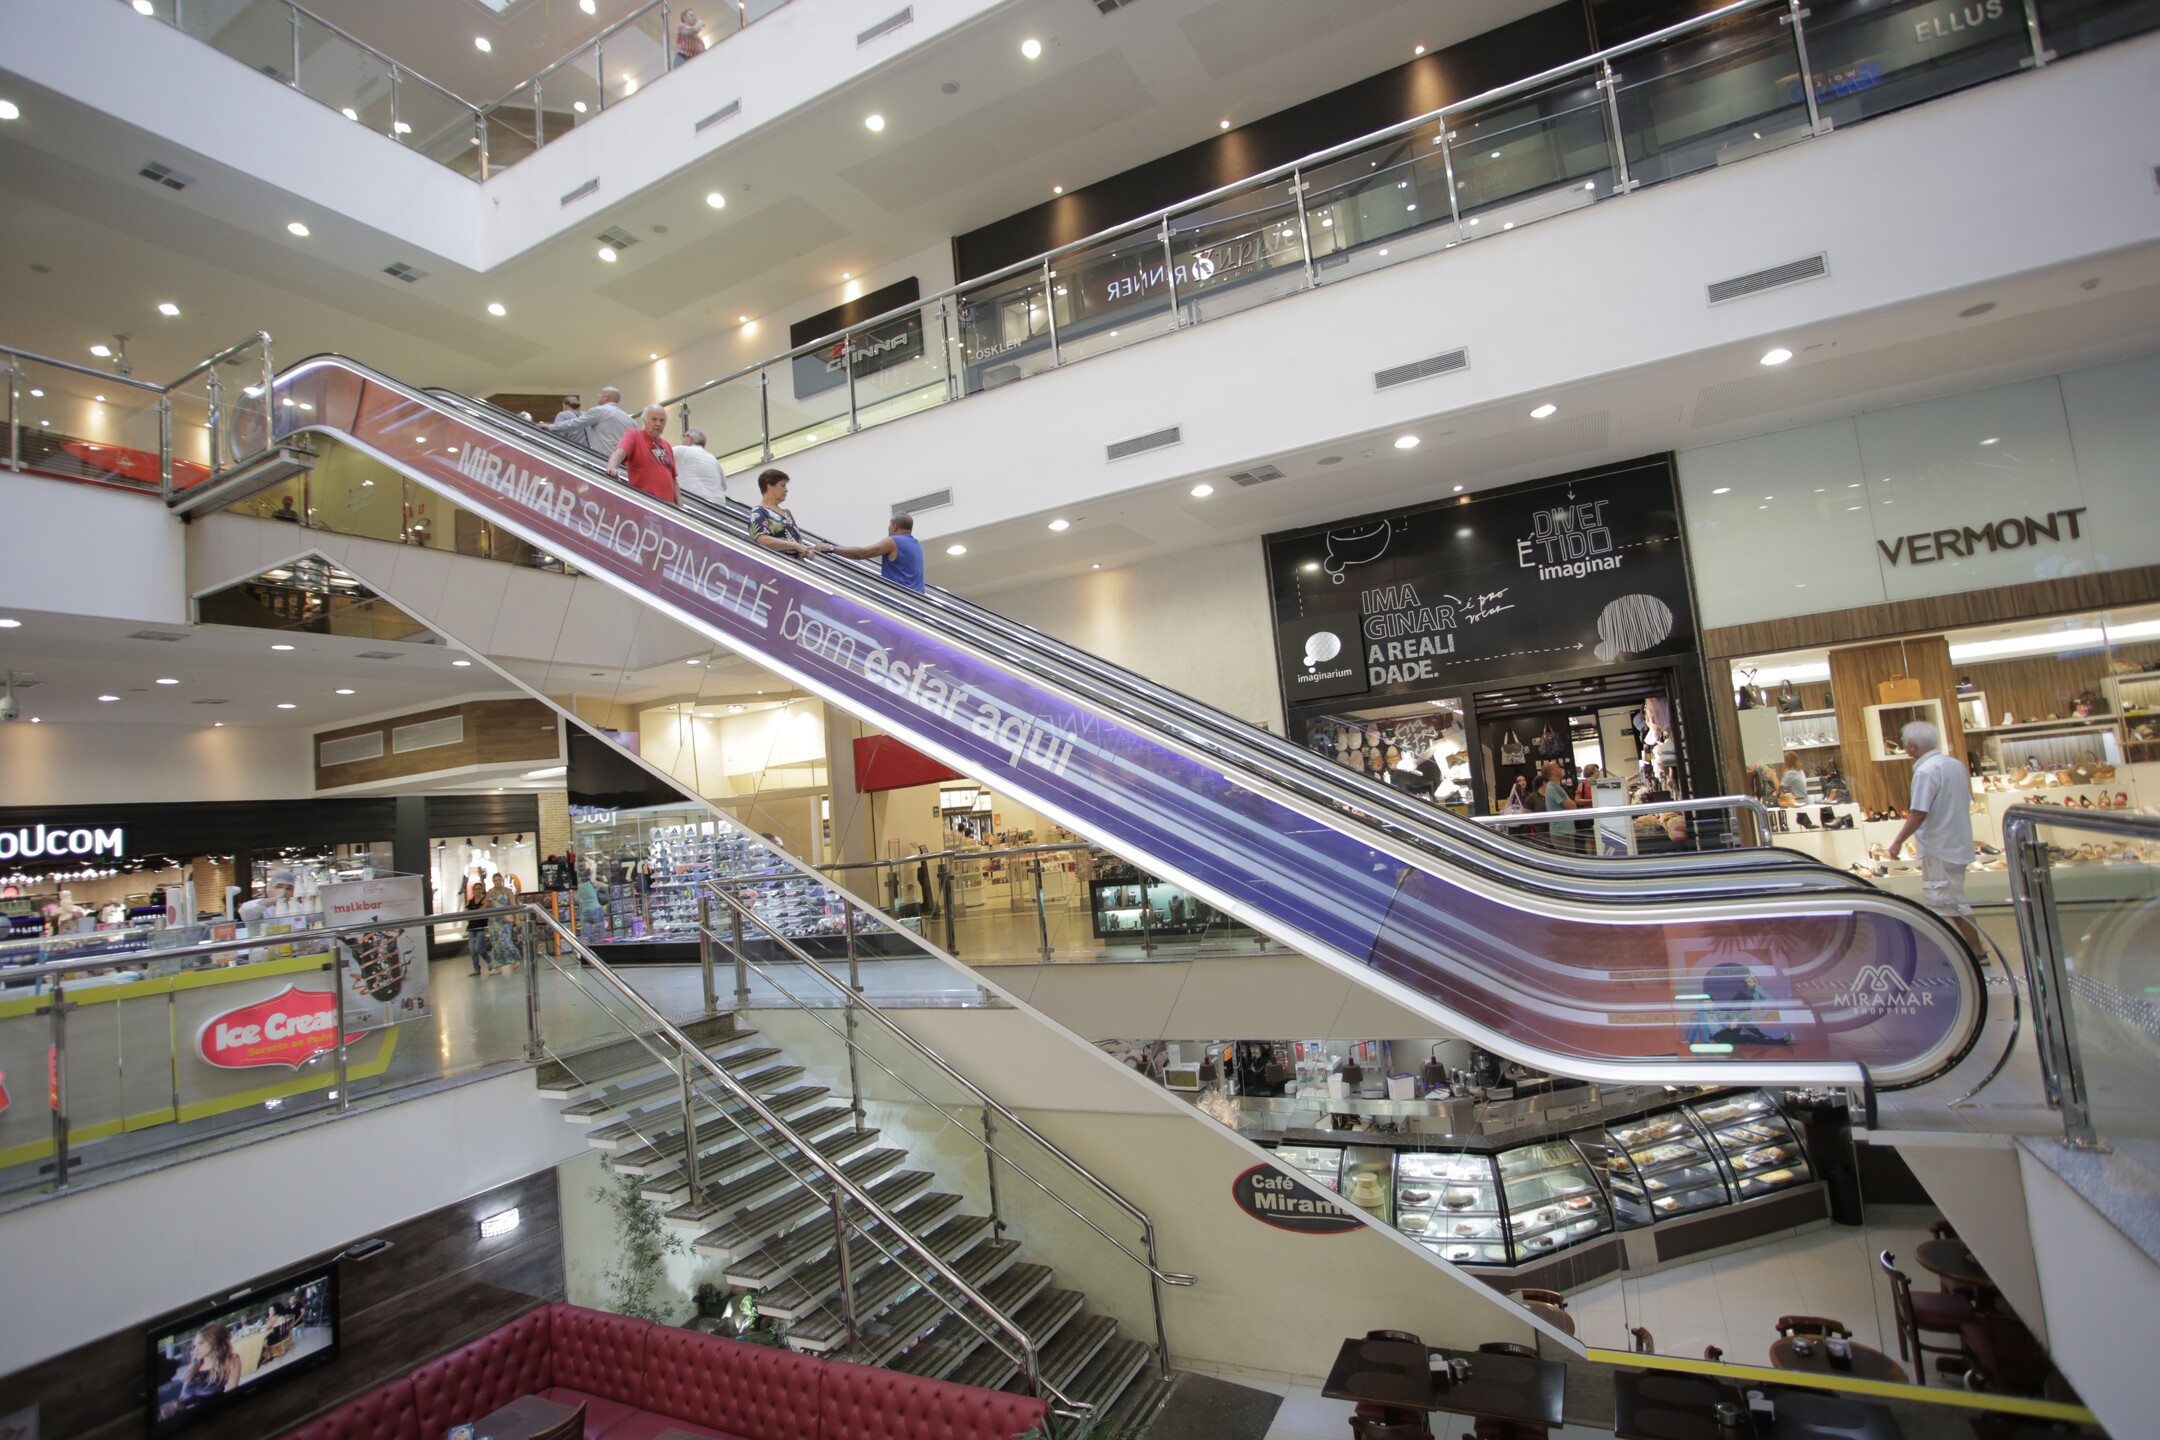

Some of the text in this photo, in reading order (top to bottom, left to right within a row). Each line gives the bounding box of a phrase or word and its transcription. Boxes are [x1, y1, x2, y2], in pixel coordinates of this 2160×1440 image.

[1915, 0, 2005, 44] ELLUS
[976, 338, 1022, 360] OSKLEN
[1535, 527, 1613, 563] TIDO
[1876, 506, 2088, 568] VERMONT
[1538, 555, 1623, 581] imaginar
[456, 440, 576, 528] MIRAMAR
[578, 502, 730, 605] SHOPPING
[779, 597, 856, 672] bom
[862, 647, 969, 723] estar
[971, 704, 1079, 778] aqui
[1361, 583, 1421, 615] IMA
[1363, 604, 1457, 640] GINAR
[1297, 667, 1353, 683] imaginarium
[1368, 659, 1440, 686] DADE.
[333, 900, 383, 914] milkbar
[1833, 992, 1934, 1007] MIRAMAR
[1853, 1007, 1917, 1015] SHOPPING
[215, 1022, 262, 1052] Ice
[1251, 1174, 1294, 1190] Café
